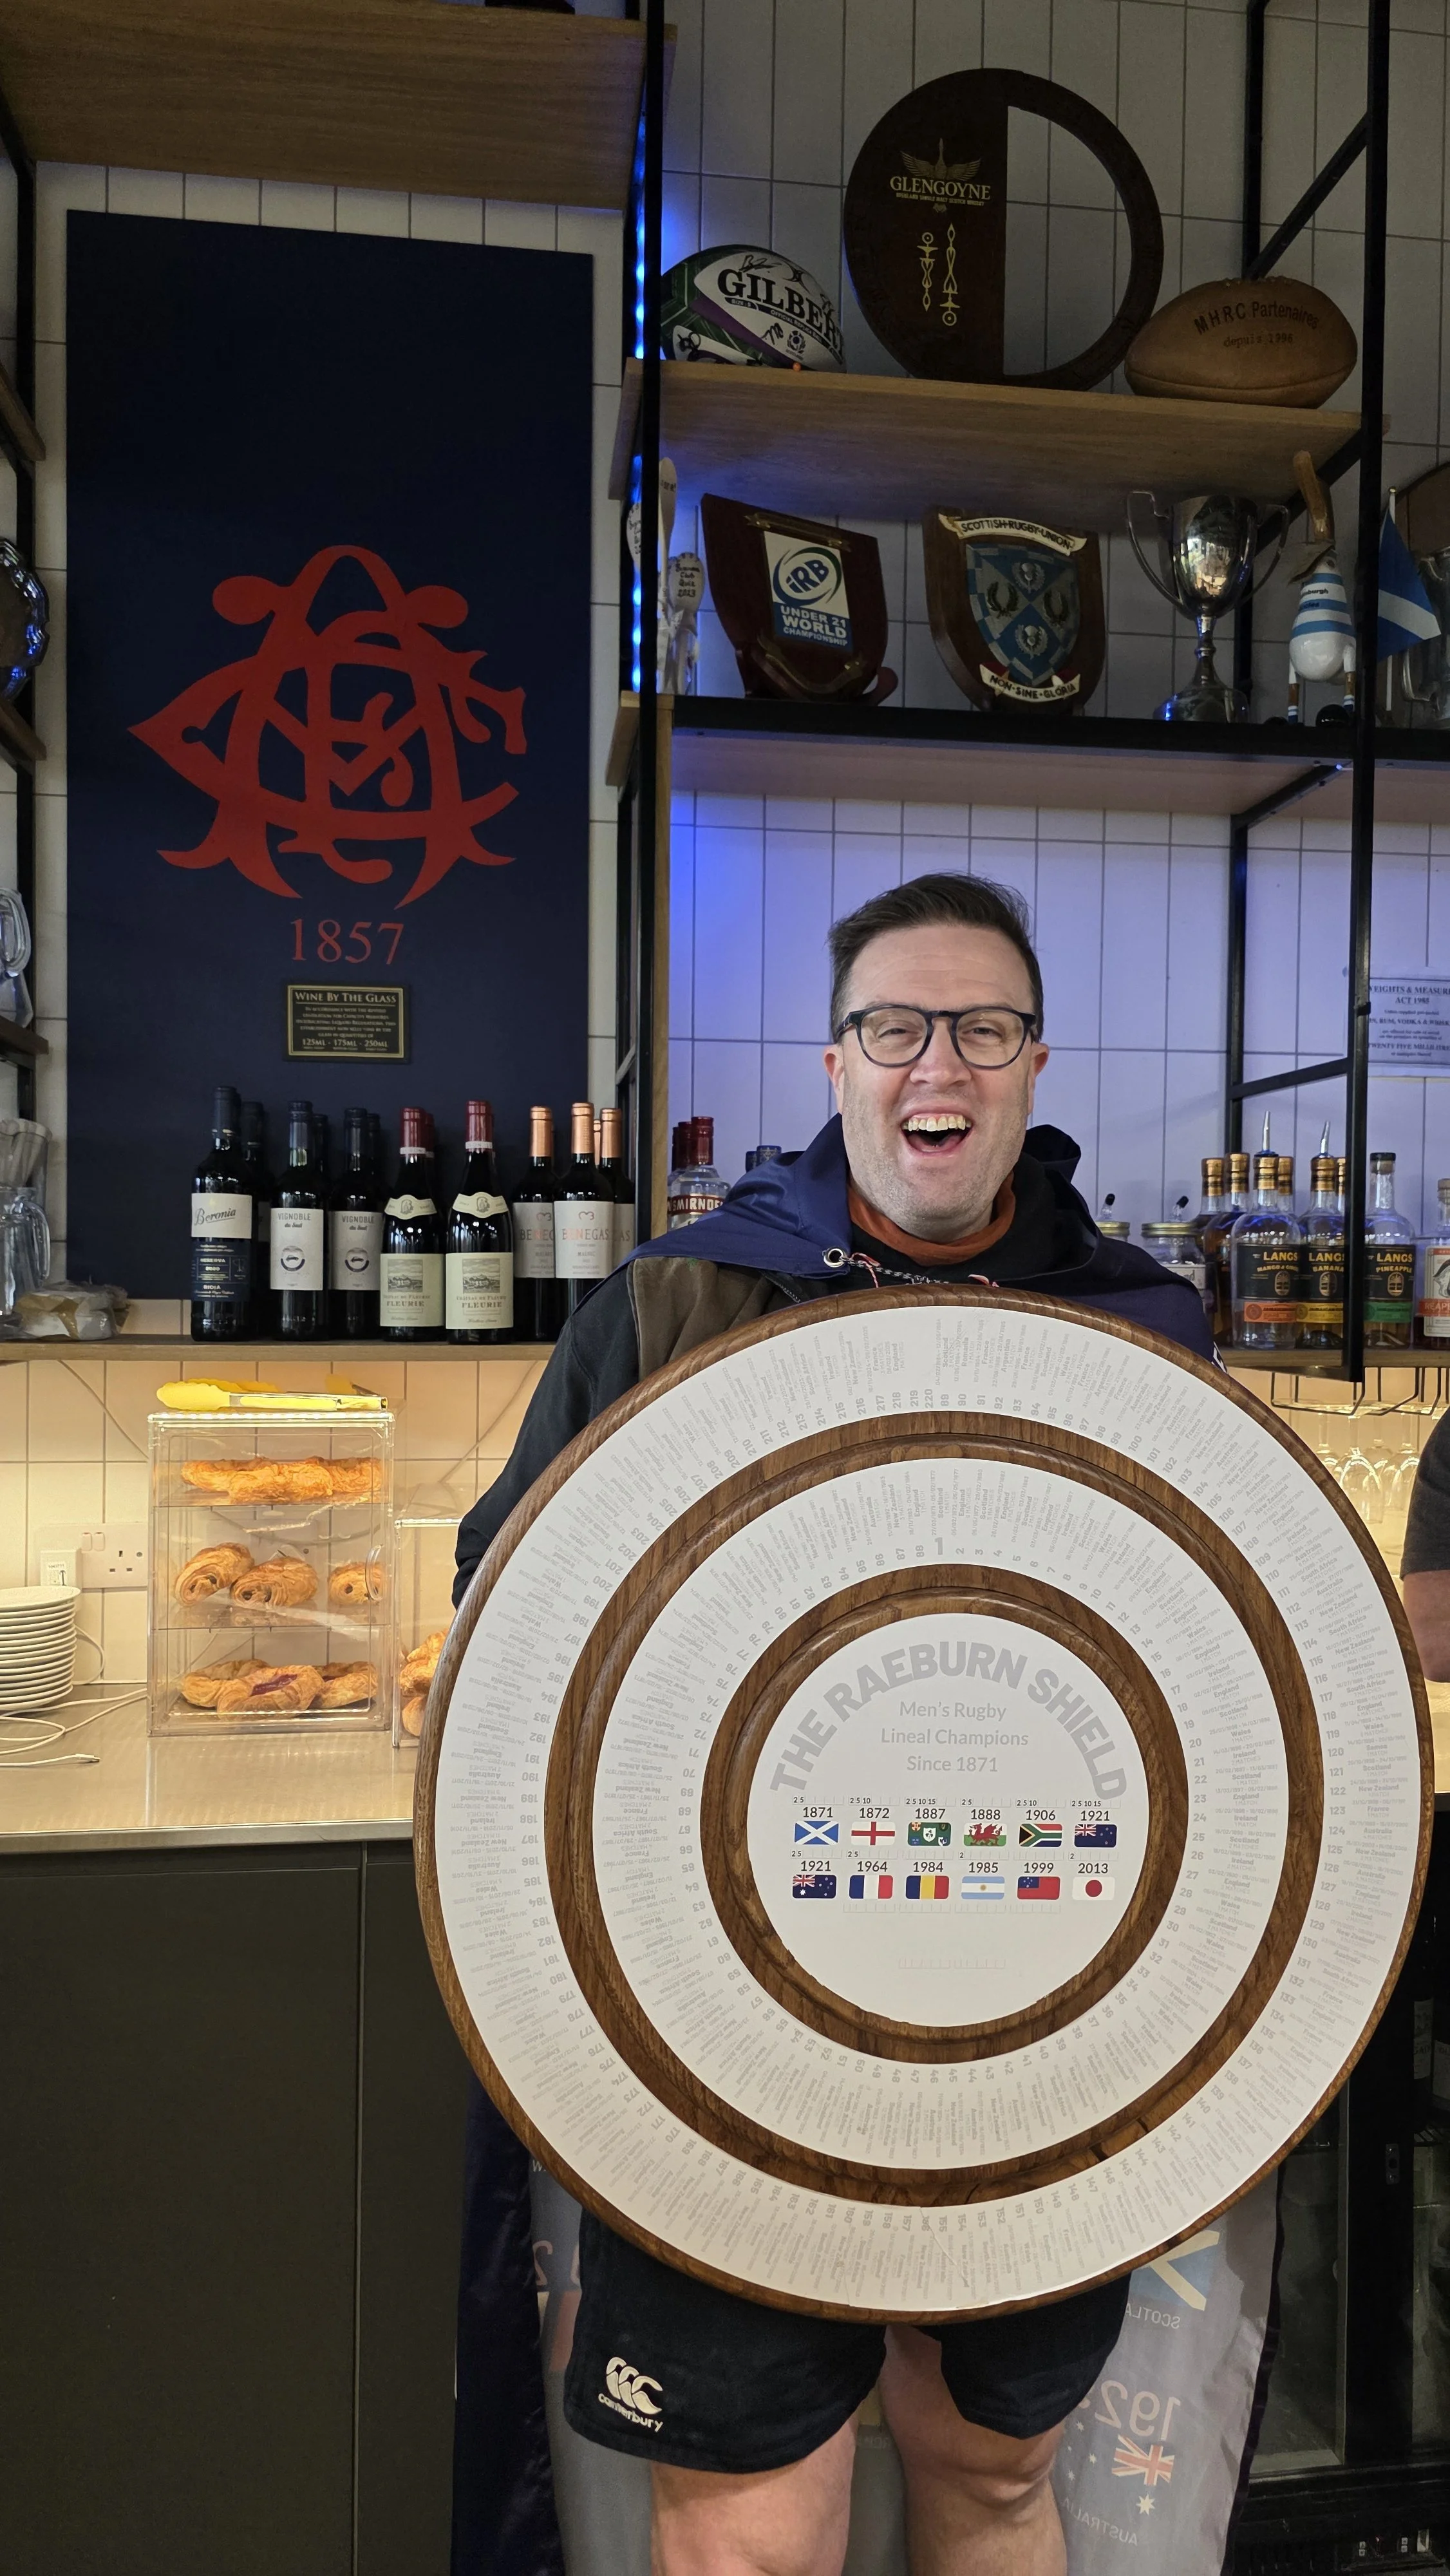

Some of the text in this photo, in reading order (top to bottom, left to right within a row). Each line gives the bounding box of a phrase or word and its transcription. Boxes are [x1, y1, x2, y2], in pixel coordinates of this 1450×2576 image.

[890, 176, 991, 200] GLENGOYNE
[1252, 300, 1319, 330] Partenaires
[780, 605, 846, 629] UNDER 21
[782, 614, 847, 638] WORLD
[782, 627, 849, 647] CHAMPIONSHIP
[290, 918, 404, 965] 1857
[295, 992, 397, 1003] WINE BY THE GLASS
[673, 1195, 721, 1211] SMIRNOF
[194, 1207, 236, 1226] Beronia
[278, 1213, 311, 1222] VIGNOBLE
[561, 1227, 608, 1241] BENEGAS
[1263, 1251, 1298, 1262] LANGS
[1377, 1253, 1413, 1263] LANGS
[876, 1395, 885, 1412] 217
[892, 1392, 901, 1409] 218
[910, 1390, 919, 1407] 219
[924, 1388, 934, 1409] 220
[941, 1394, 950, 1406] 89
[958, 1393, 967, 1406] 90
[977, 1394, 986, 1406] 91
[993, 1396, 1004, 1410] 92
[1012, 1399, 1022, 1412] 93
[835, 1401, 847, 1419] 215
[856, 1397, 867, 1416] 216
[1047, 1406, 1057, 1420] 95
[814, 1407, 827, 1426] 214
[777, 1420, 790, 1438] 212
[1078, 1417, 1089, 1432] 97
[1127, 1435, 1142, 1452] 100
[980, 1489, 988, 1520] Scotland
[1001, 1492, 1010, 1520] England
[1042, 1504, 1054, 1531] England
[915, 1545, 925, 1558] 88
[935, 1537, 943, 1555] 1
[875, 1553, 885, 1567] 86
[896, 1548, 905, 1560] 87
[899, 1701, 1007, 1723] Men's Rugby
[769, 1641, 1127, 1800] THE RAEBURN SHIELD
[881, 1728, 1029, 1748] Lineal Champions
[1328, 1747, 1344, 1757] 120
[907, 1756, 998, 1773] Since 1871
[522, 1772, 539, 1782] 190
[1329, 1767, 1344, 1777] 121
[1330, 1786, 1346, 1795] 122
[803, 1806, 833, 1818] 1871
[859, 1807, 890, 1819] 1872
[915, 1808, 946, 1819] 1887
[971, 1808, 1001, 1821] 1888
[1026, 1809, 1056, 1821] 1906
[1080, 1810, 1110, 1821] 1921
[1329, 1806, 1346, 1815] 123
[800, 1861, 831, 1871] 1921
[857, 1861, 888, 1872] 1964
[913, 1861, 943, 1873] 1984
[968, 1862, 999, 1873] 1985
[1024, 1862, 1054, 1873] 1999
[1078, 1862, 1108, 1874] 2013
[598, 2393, 663, 2432] canterbury
